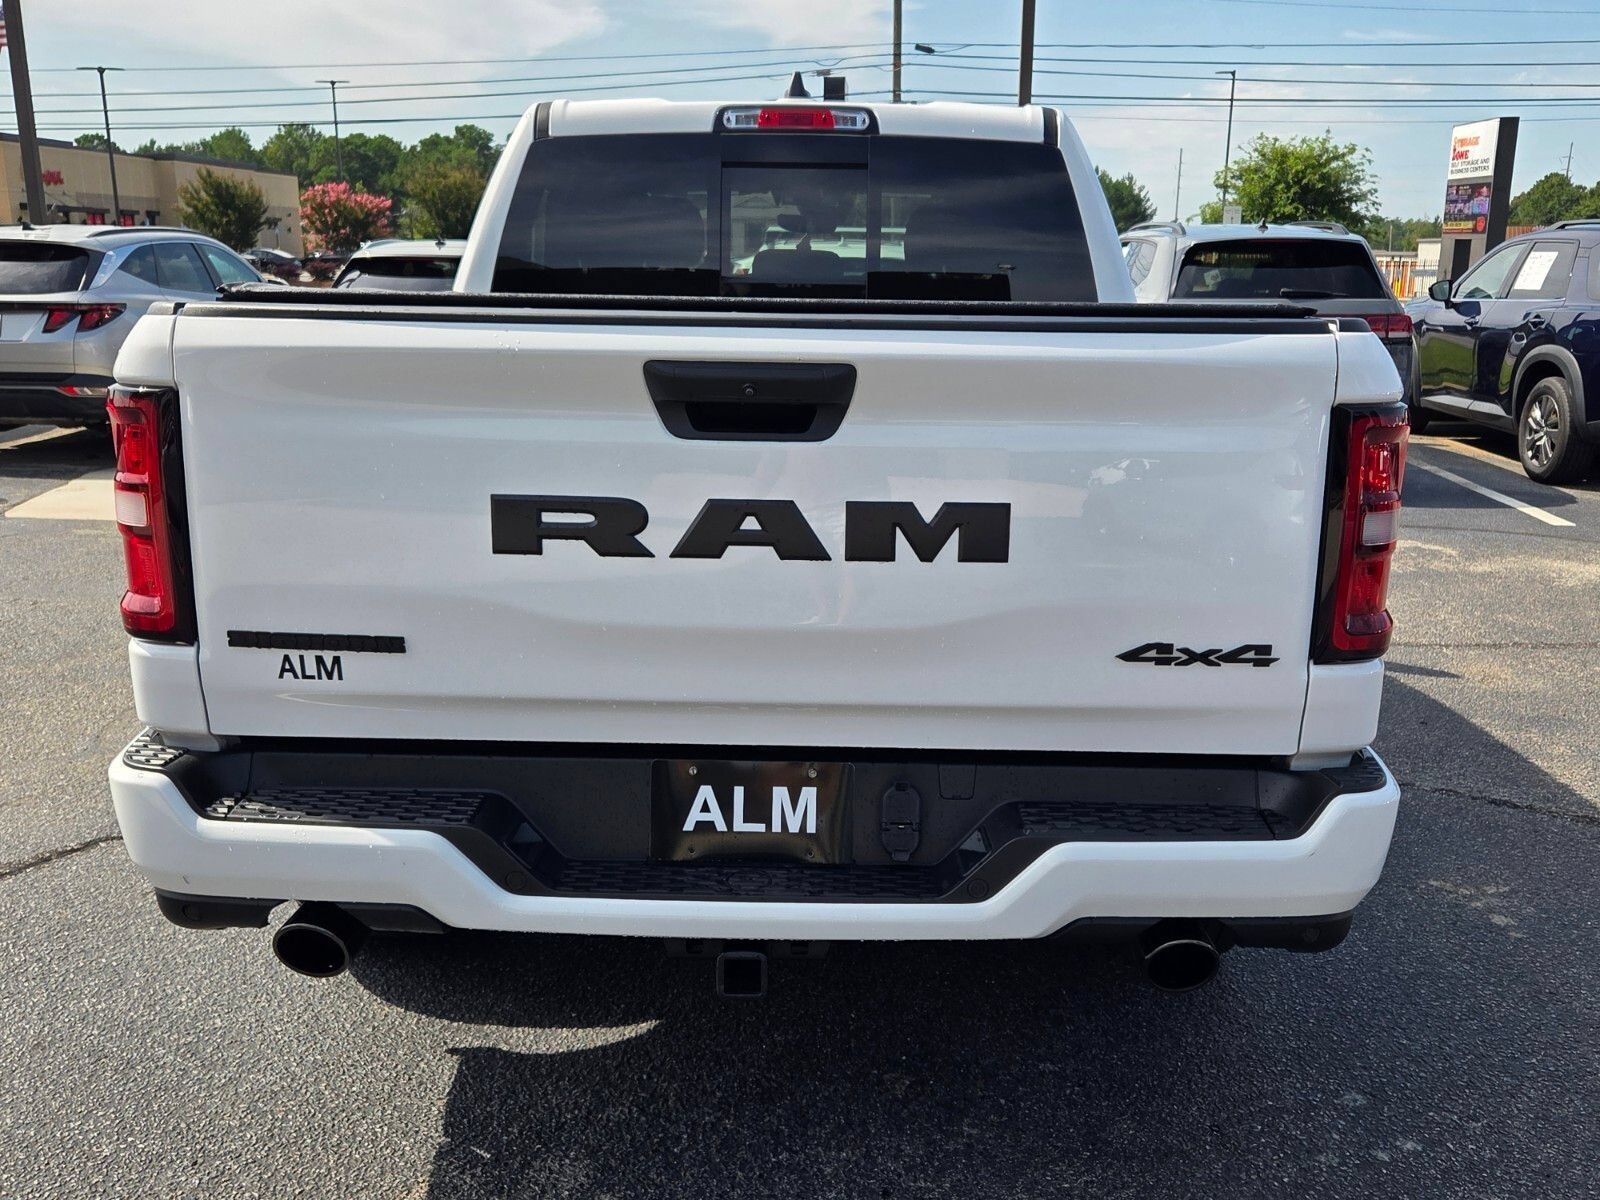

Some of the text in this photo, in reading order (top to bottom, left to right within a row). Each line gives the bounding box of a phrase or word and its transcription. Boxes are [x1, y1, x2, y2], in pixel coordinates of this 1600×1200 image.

[490, 493, 1012, 563] RAM
[278, 654, 343, 681] ALM
[682, 785, 817, 834] ALM
